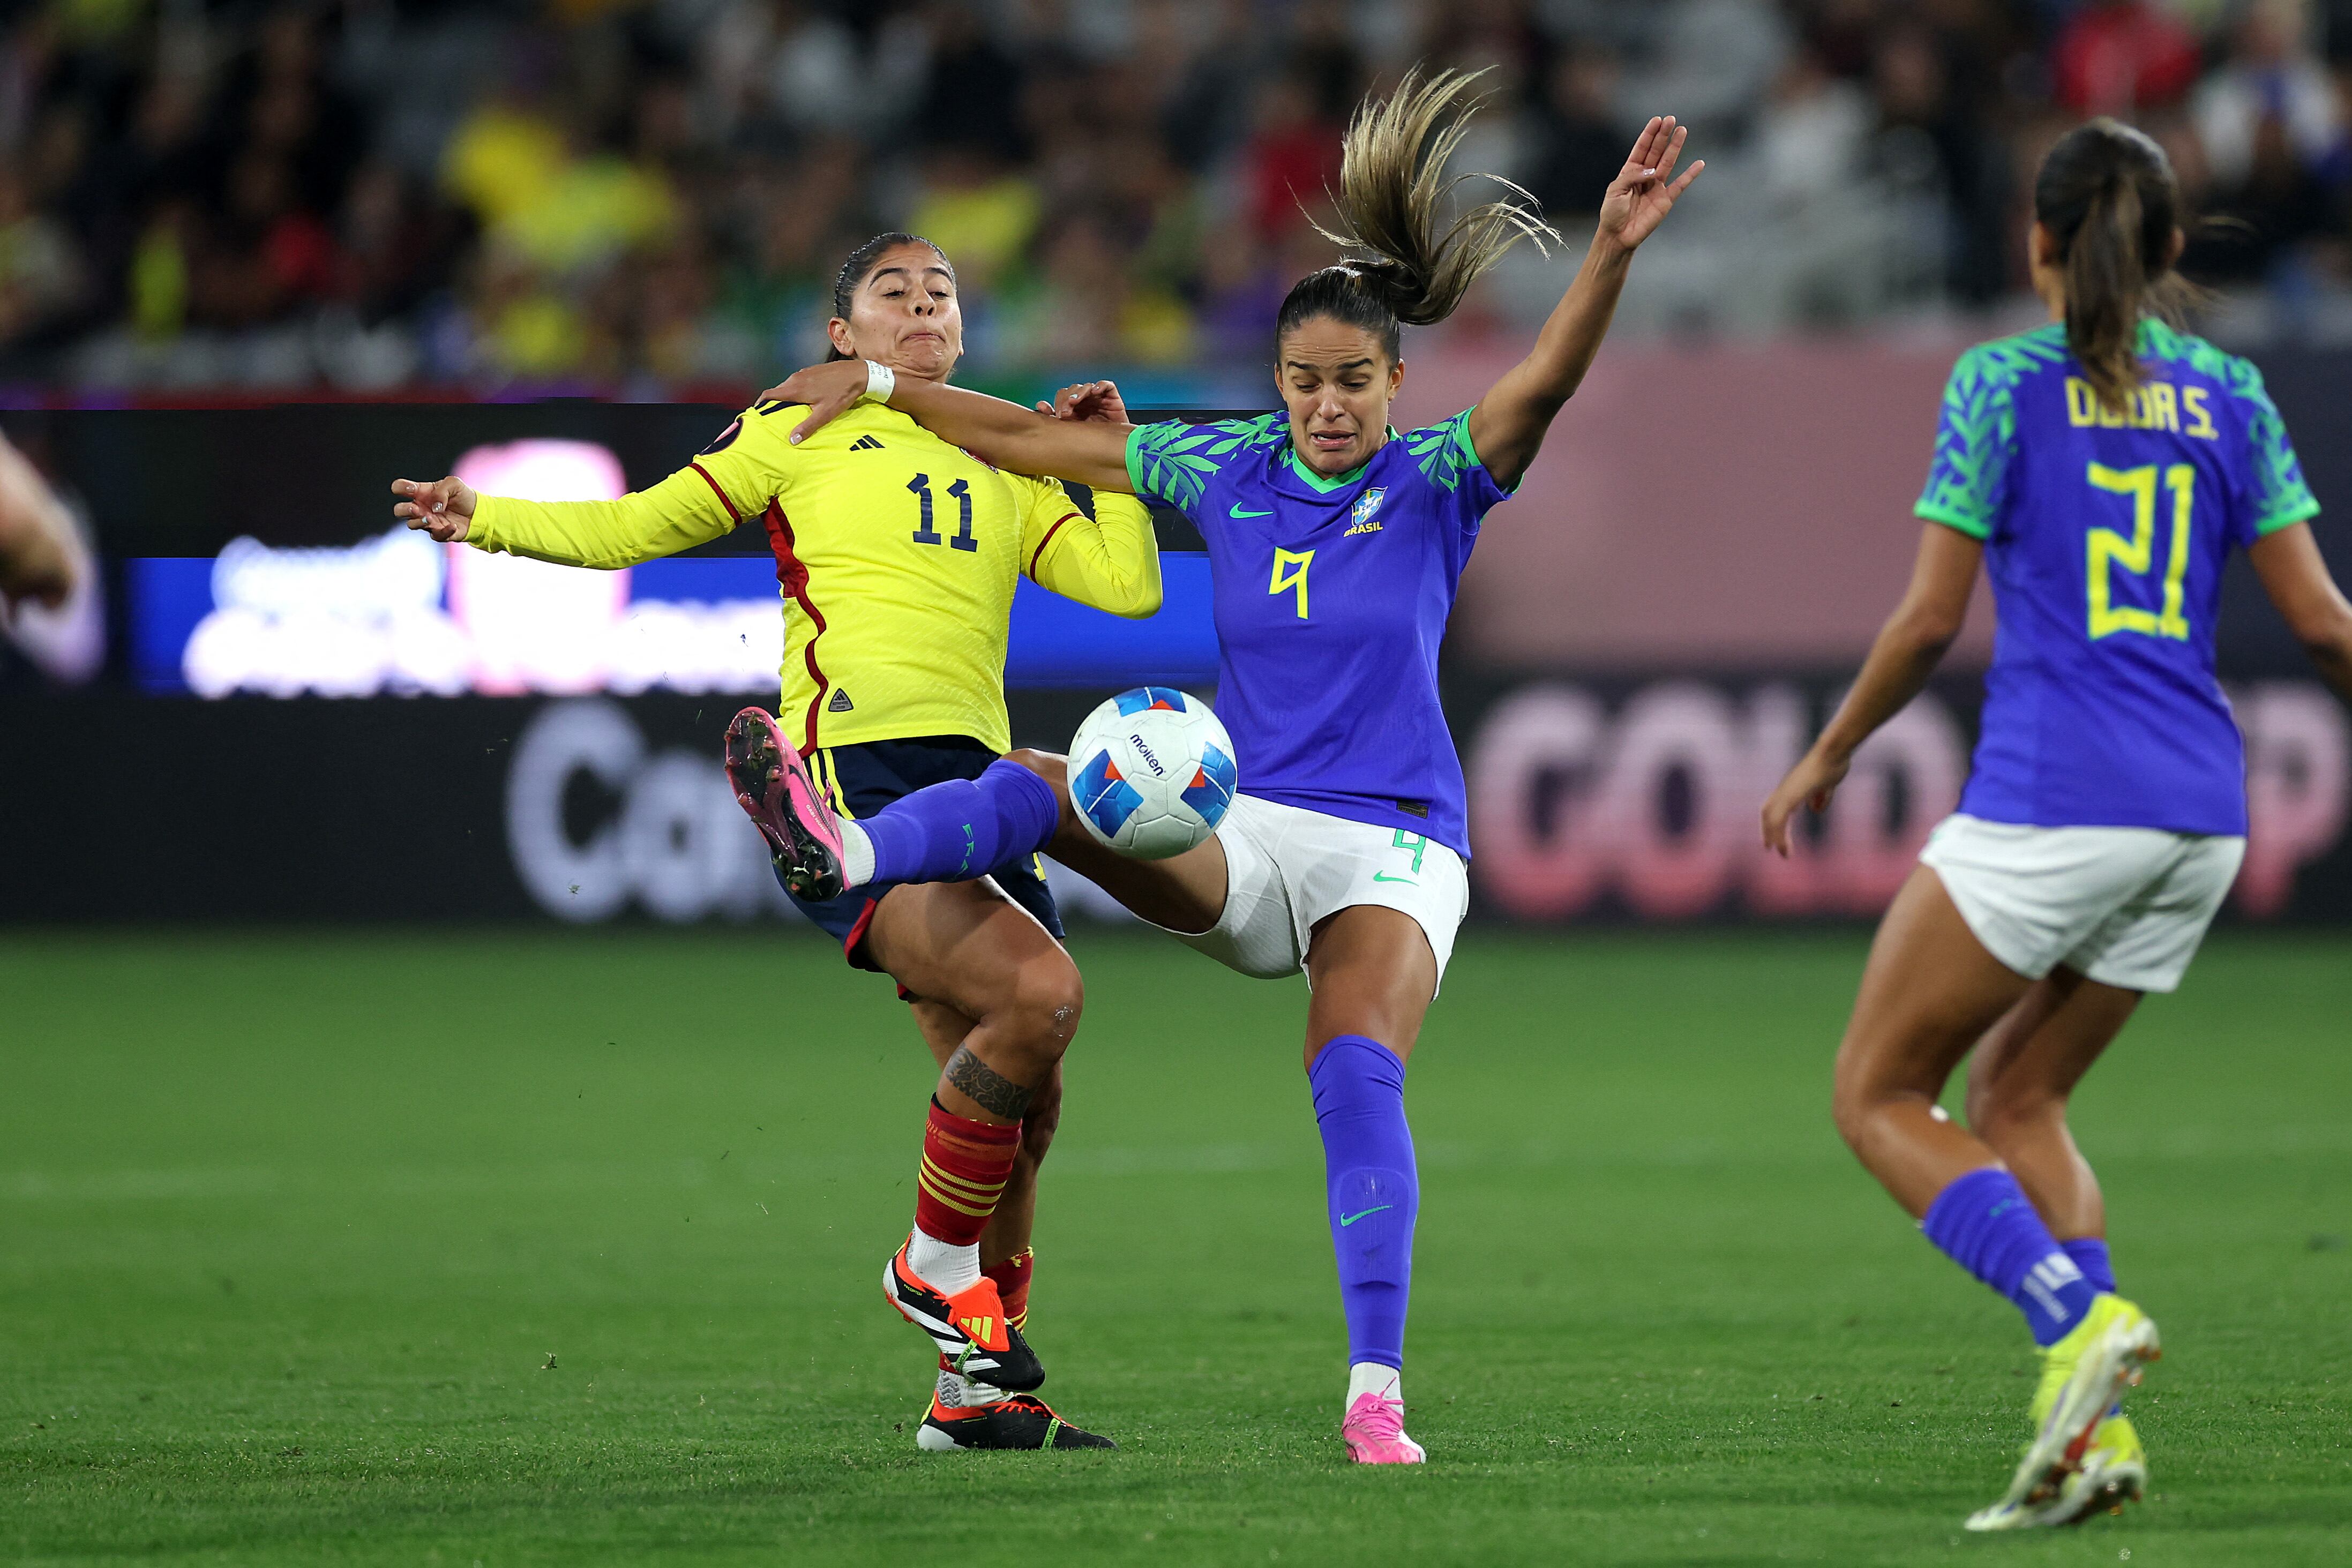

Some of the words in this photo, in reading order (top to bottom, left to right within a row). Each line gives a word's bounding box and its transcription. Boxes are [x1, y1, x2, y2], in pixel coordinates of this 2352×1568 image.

[906, 472, 978, 553] 11
[1343, 521, 1383, 537] BRASIL
[1268, 545, 1316, 620] 9
[2086, 459, 2196, 643] 21
[1129, 734, 1164, 777] molten
